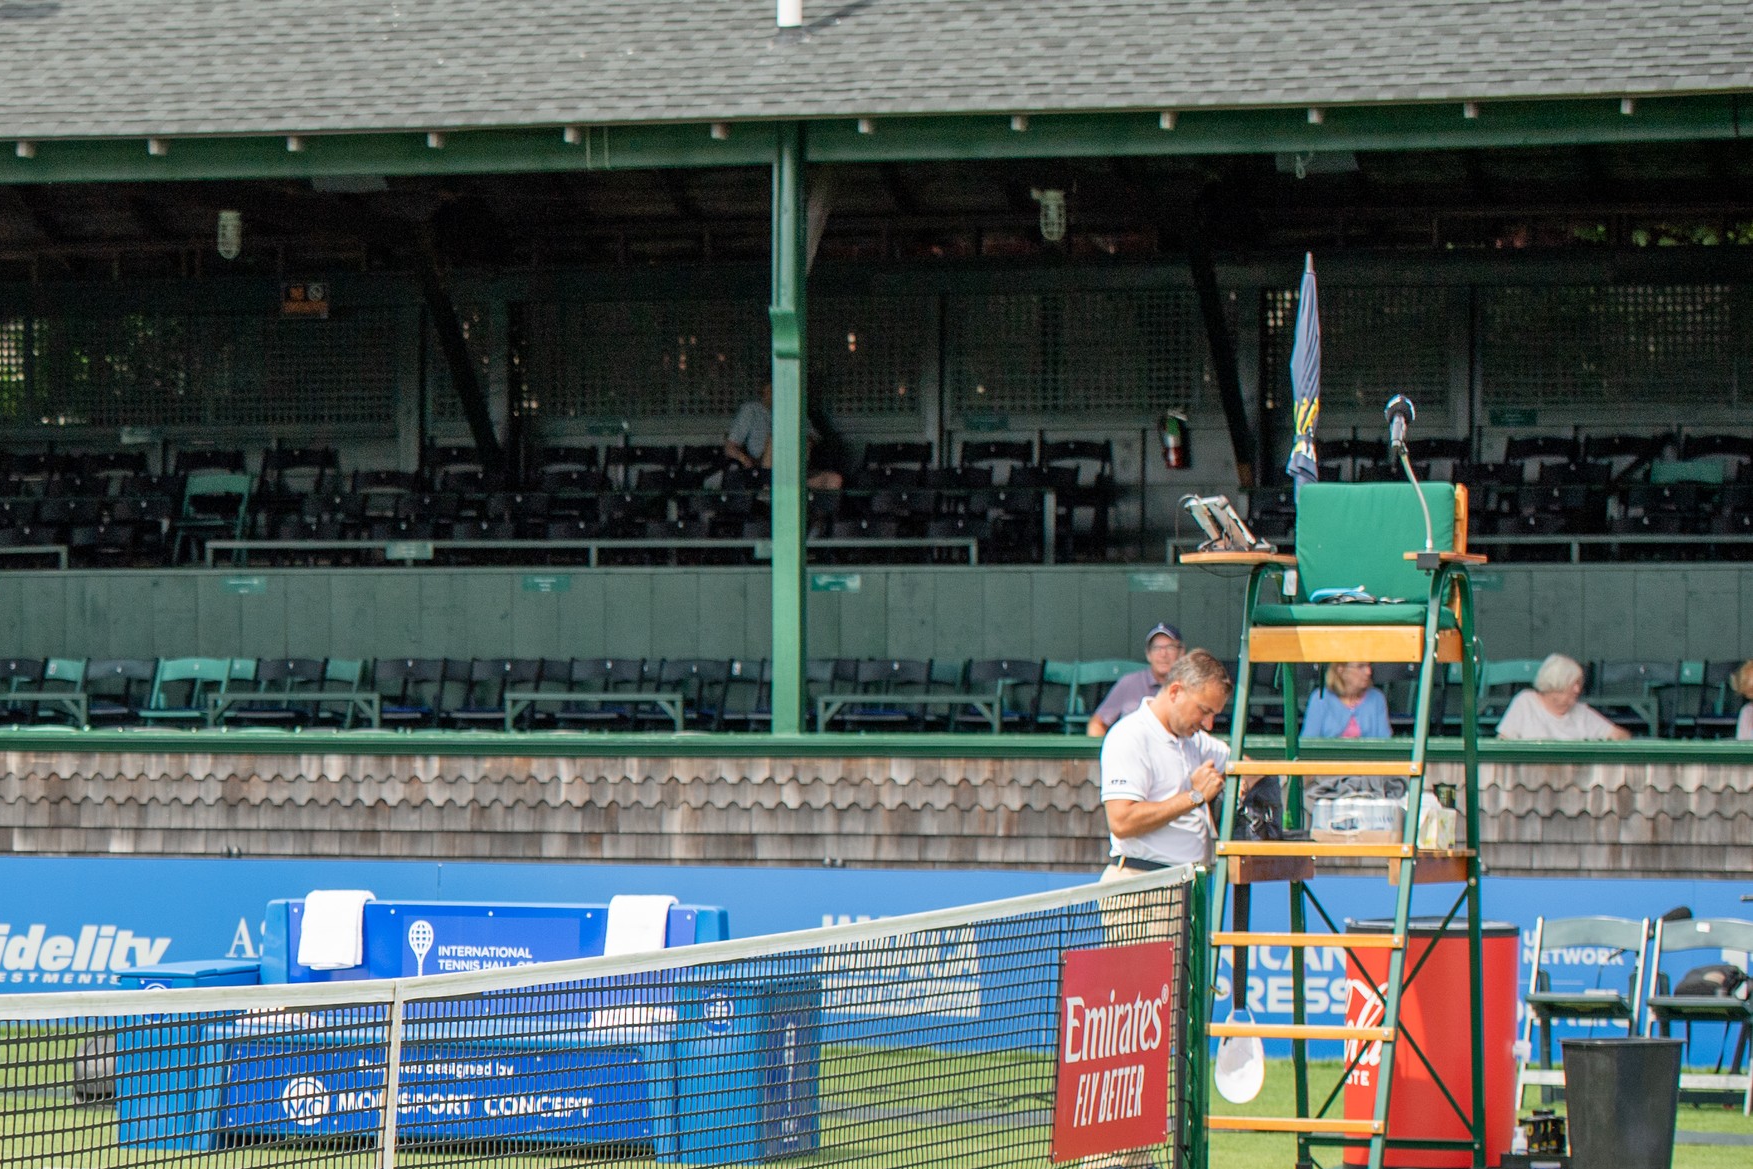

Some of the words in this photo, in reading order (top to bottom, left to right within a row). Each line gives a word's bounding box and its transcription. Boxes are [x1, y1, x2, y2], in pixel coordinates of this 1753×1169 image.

[438, 945, 533, 959] INTERNATIONAL
[438, 960, 481, 971] TENNIS
[1065, 989, 1163, 1063] Emirates
[1073, 1072, 1100, 1128] FLY
[1098, 1064, 1145, 1123] BETTER
